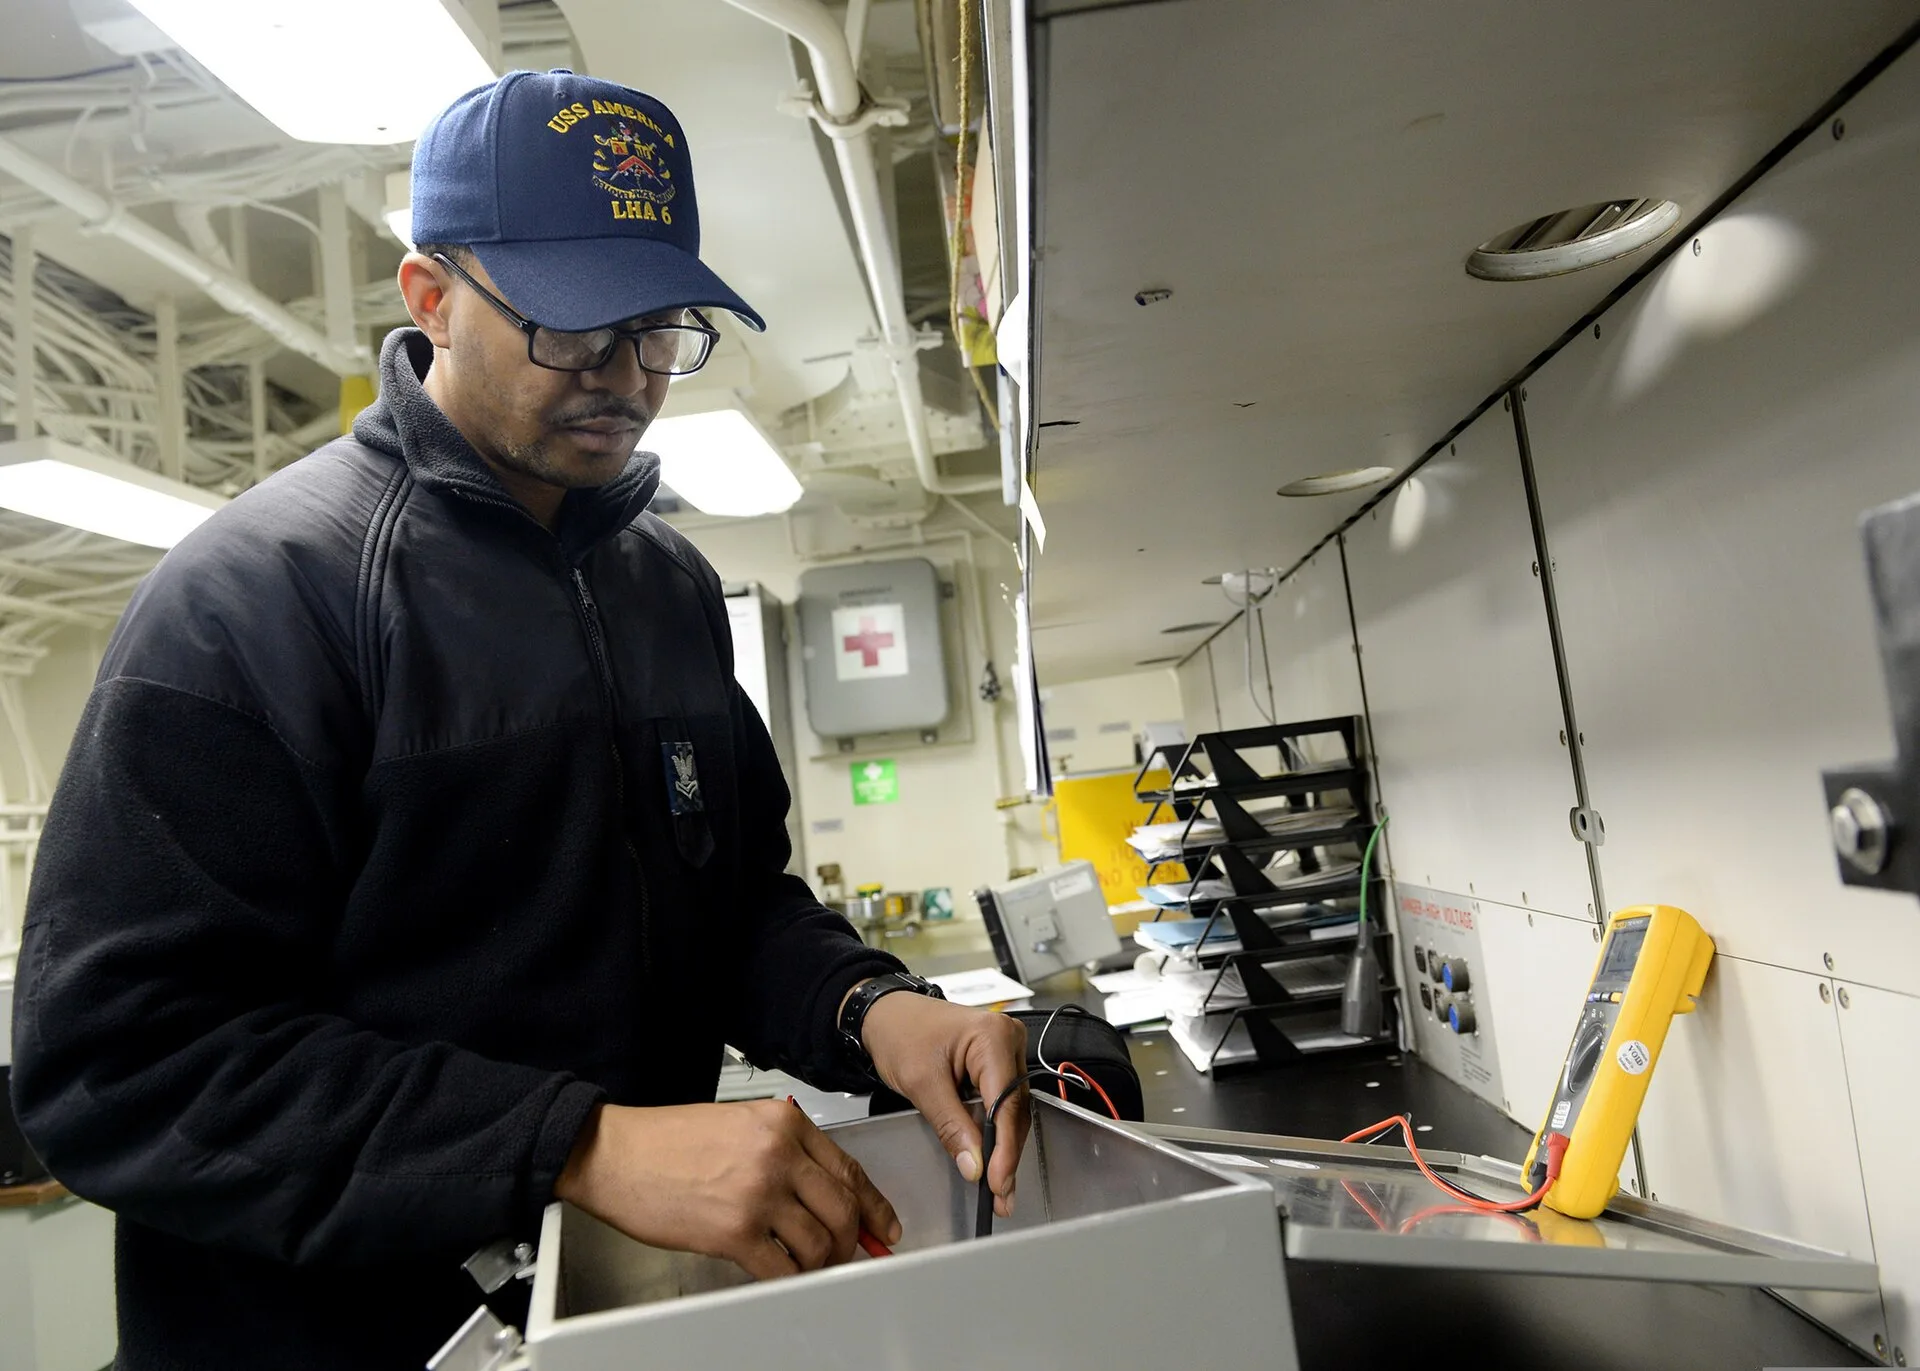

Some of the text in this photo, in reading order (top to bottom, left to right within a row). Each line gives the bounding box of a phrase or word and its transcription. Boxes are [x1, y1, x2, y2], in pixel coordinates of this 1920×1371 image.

[547, 99, 675, 149] USS AMERICA
[611, 200, 672, 225] LHA 6
[1443, 906, 1473, 930] VOLTAGE
[1628, 1044, 1643, 1066] VOID
